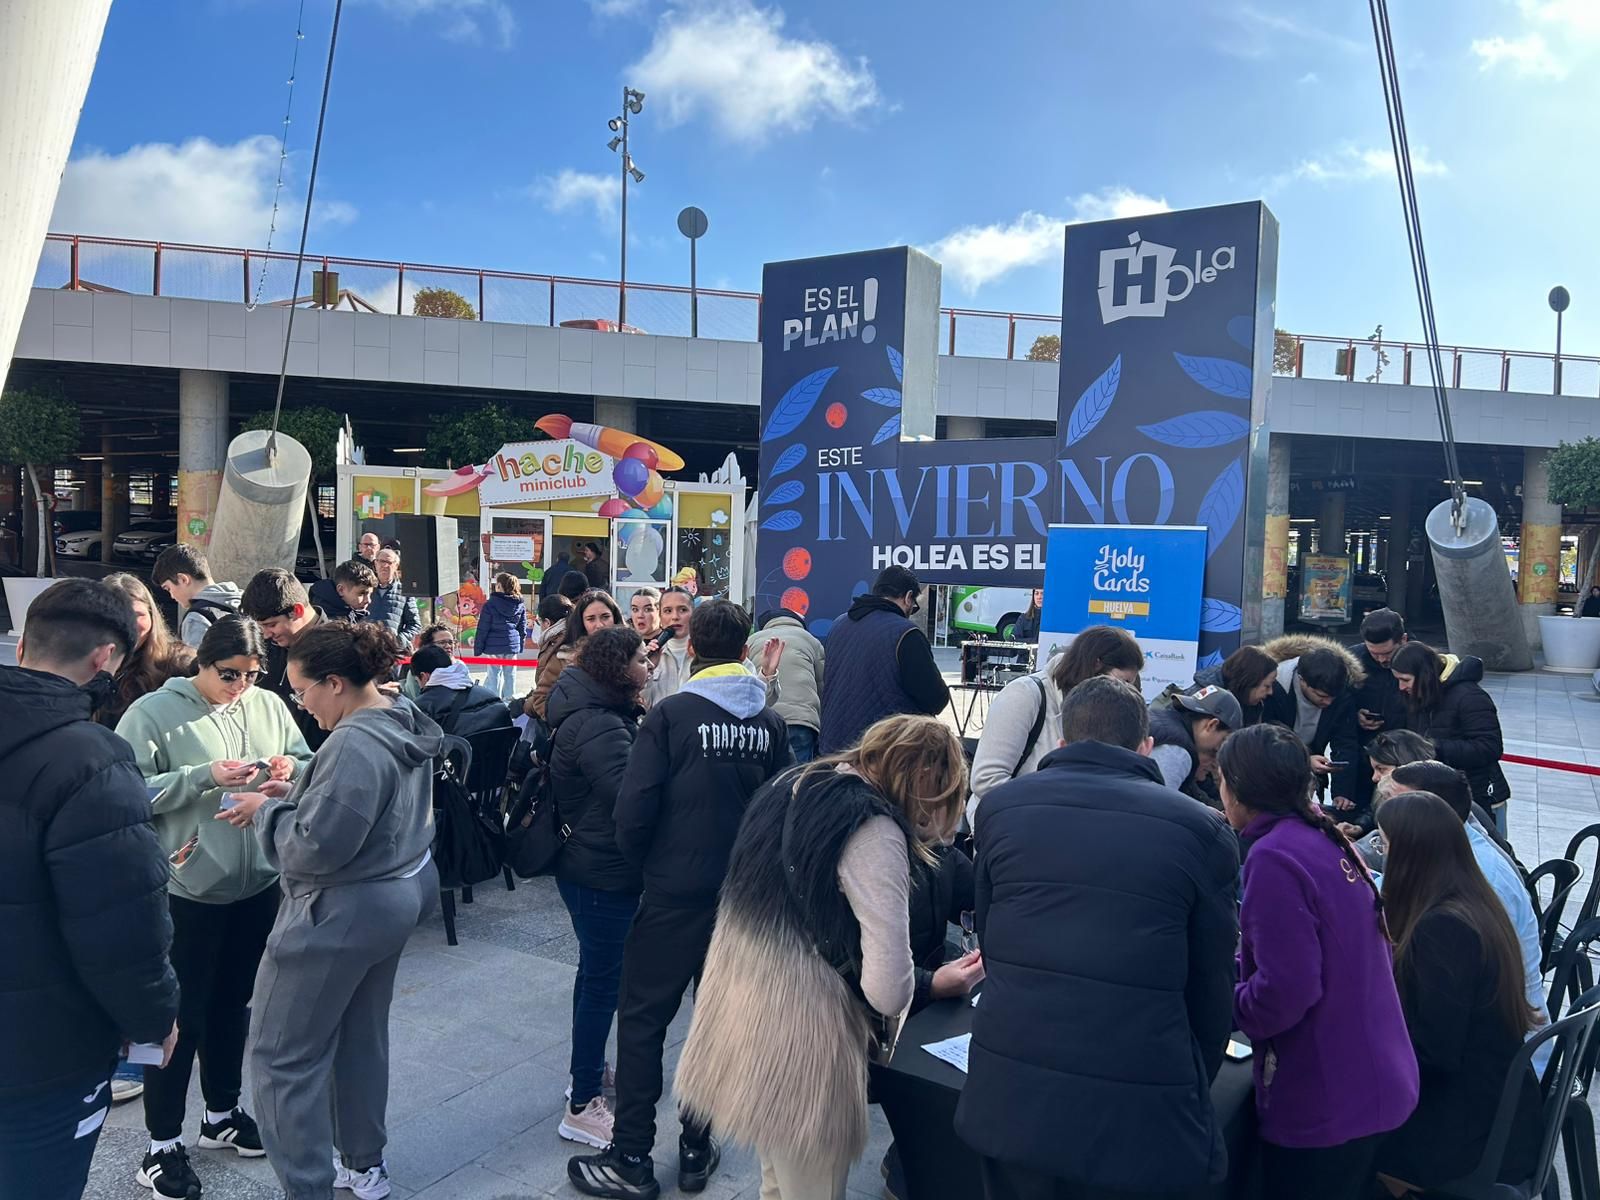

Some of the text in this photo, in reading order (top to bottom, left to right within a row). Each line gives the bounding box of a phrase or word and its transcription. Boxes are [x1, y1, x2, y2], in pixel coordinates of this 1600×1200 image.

[804, 285, 859, 312] ES EL
[495, 443, 604, 482] hache
[818, 447, 863, 467] ESTE
[519, 475, 587, 492] miniclub
[816, 452, 1176, 541] INVIERNO
[872, 544, 1046, 570] HOLEA ES EL
[1095, 544, 1145, 574] Holy
[1093, 568, 1150, 592] Cards
[1103, 600, 1134, 614] HUELVA
[698, 722, 769, 752] TRAPSTAR
[703, 751, 766, 759] LONDO
